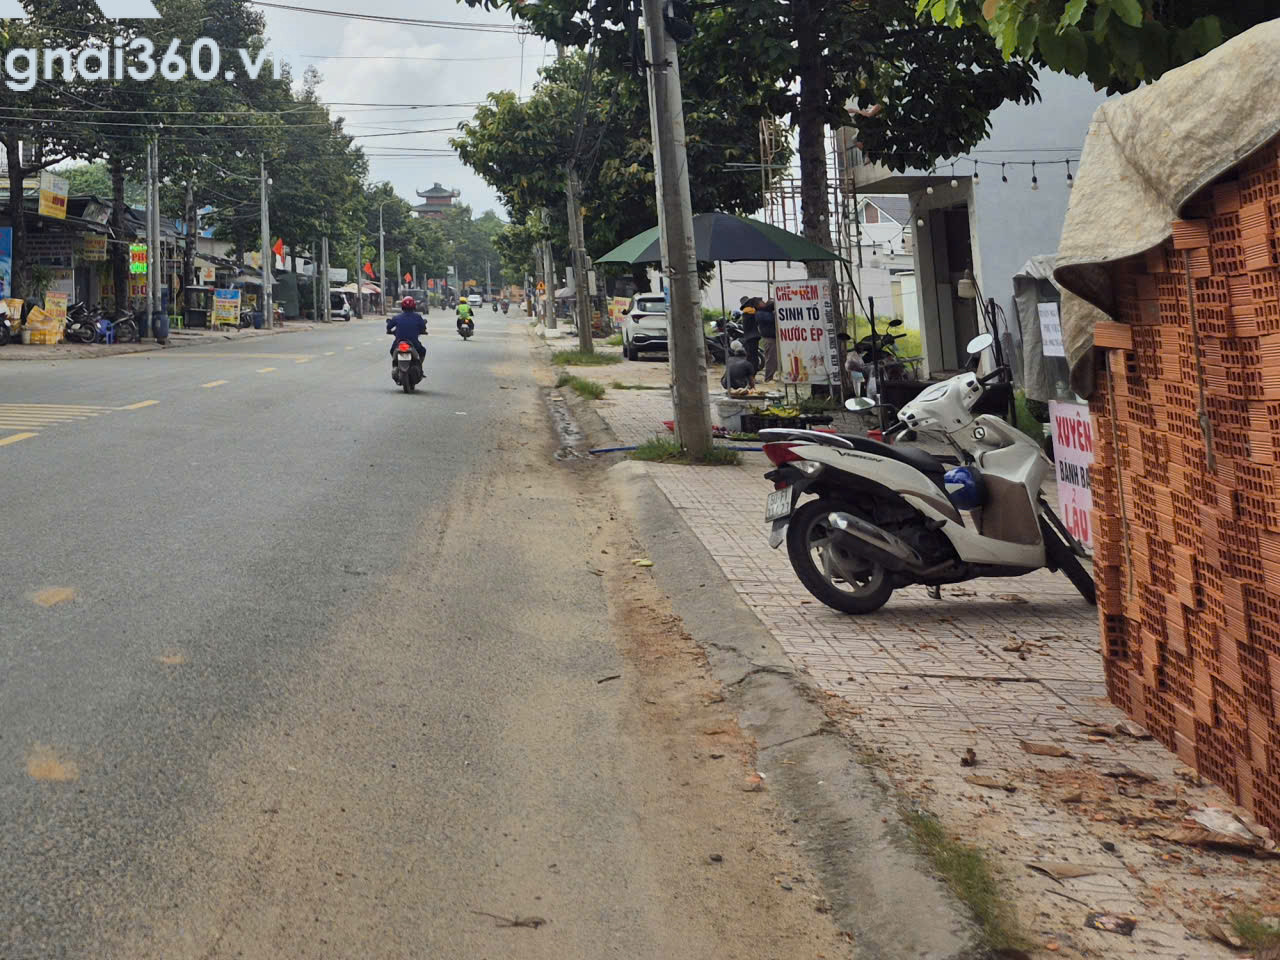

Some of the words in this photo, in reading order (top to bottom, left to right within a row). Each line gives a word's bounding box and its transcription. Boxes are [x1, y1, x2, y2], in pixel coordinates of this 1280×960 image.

[131, 251, 147, 264] PH
[778, 307, 804, 321] SINH
[806, 302, 820, 321] TỐ
[780, 325, 808, 342] NƯỚC
[810, 325, 824, 342] ÉP
[1055, 411, 1093, 453] XUYÊN
[1059, 457, 1079, 486] BÁNH
[1080, 466, 1091, 490] BA
